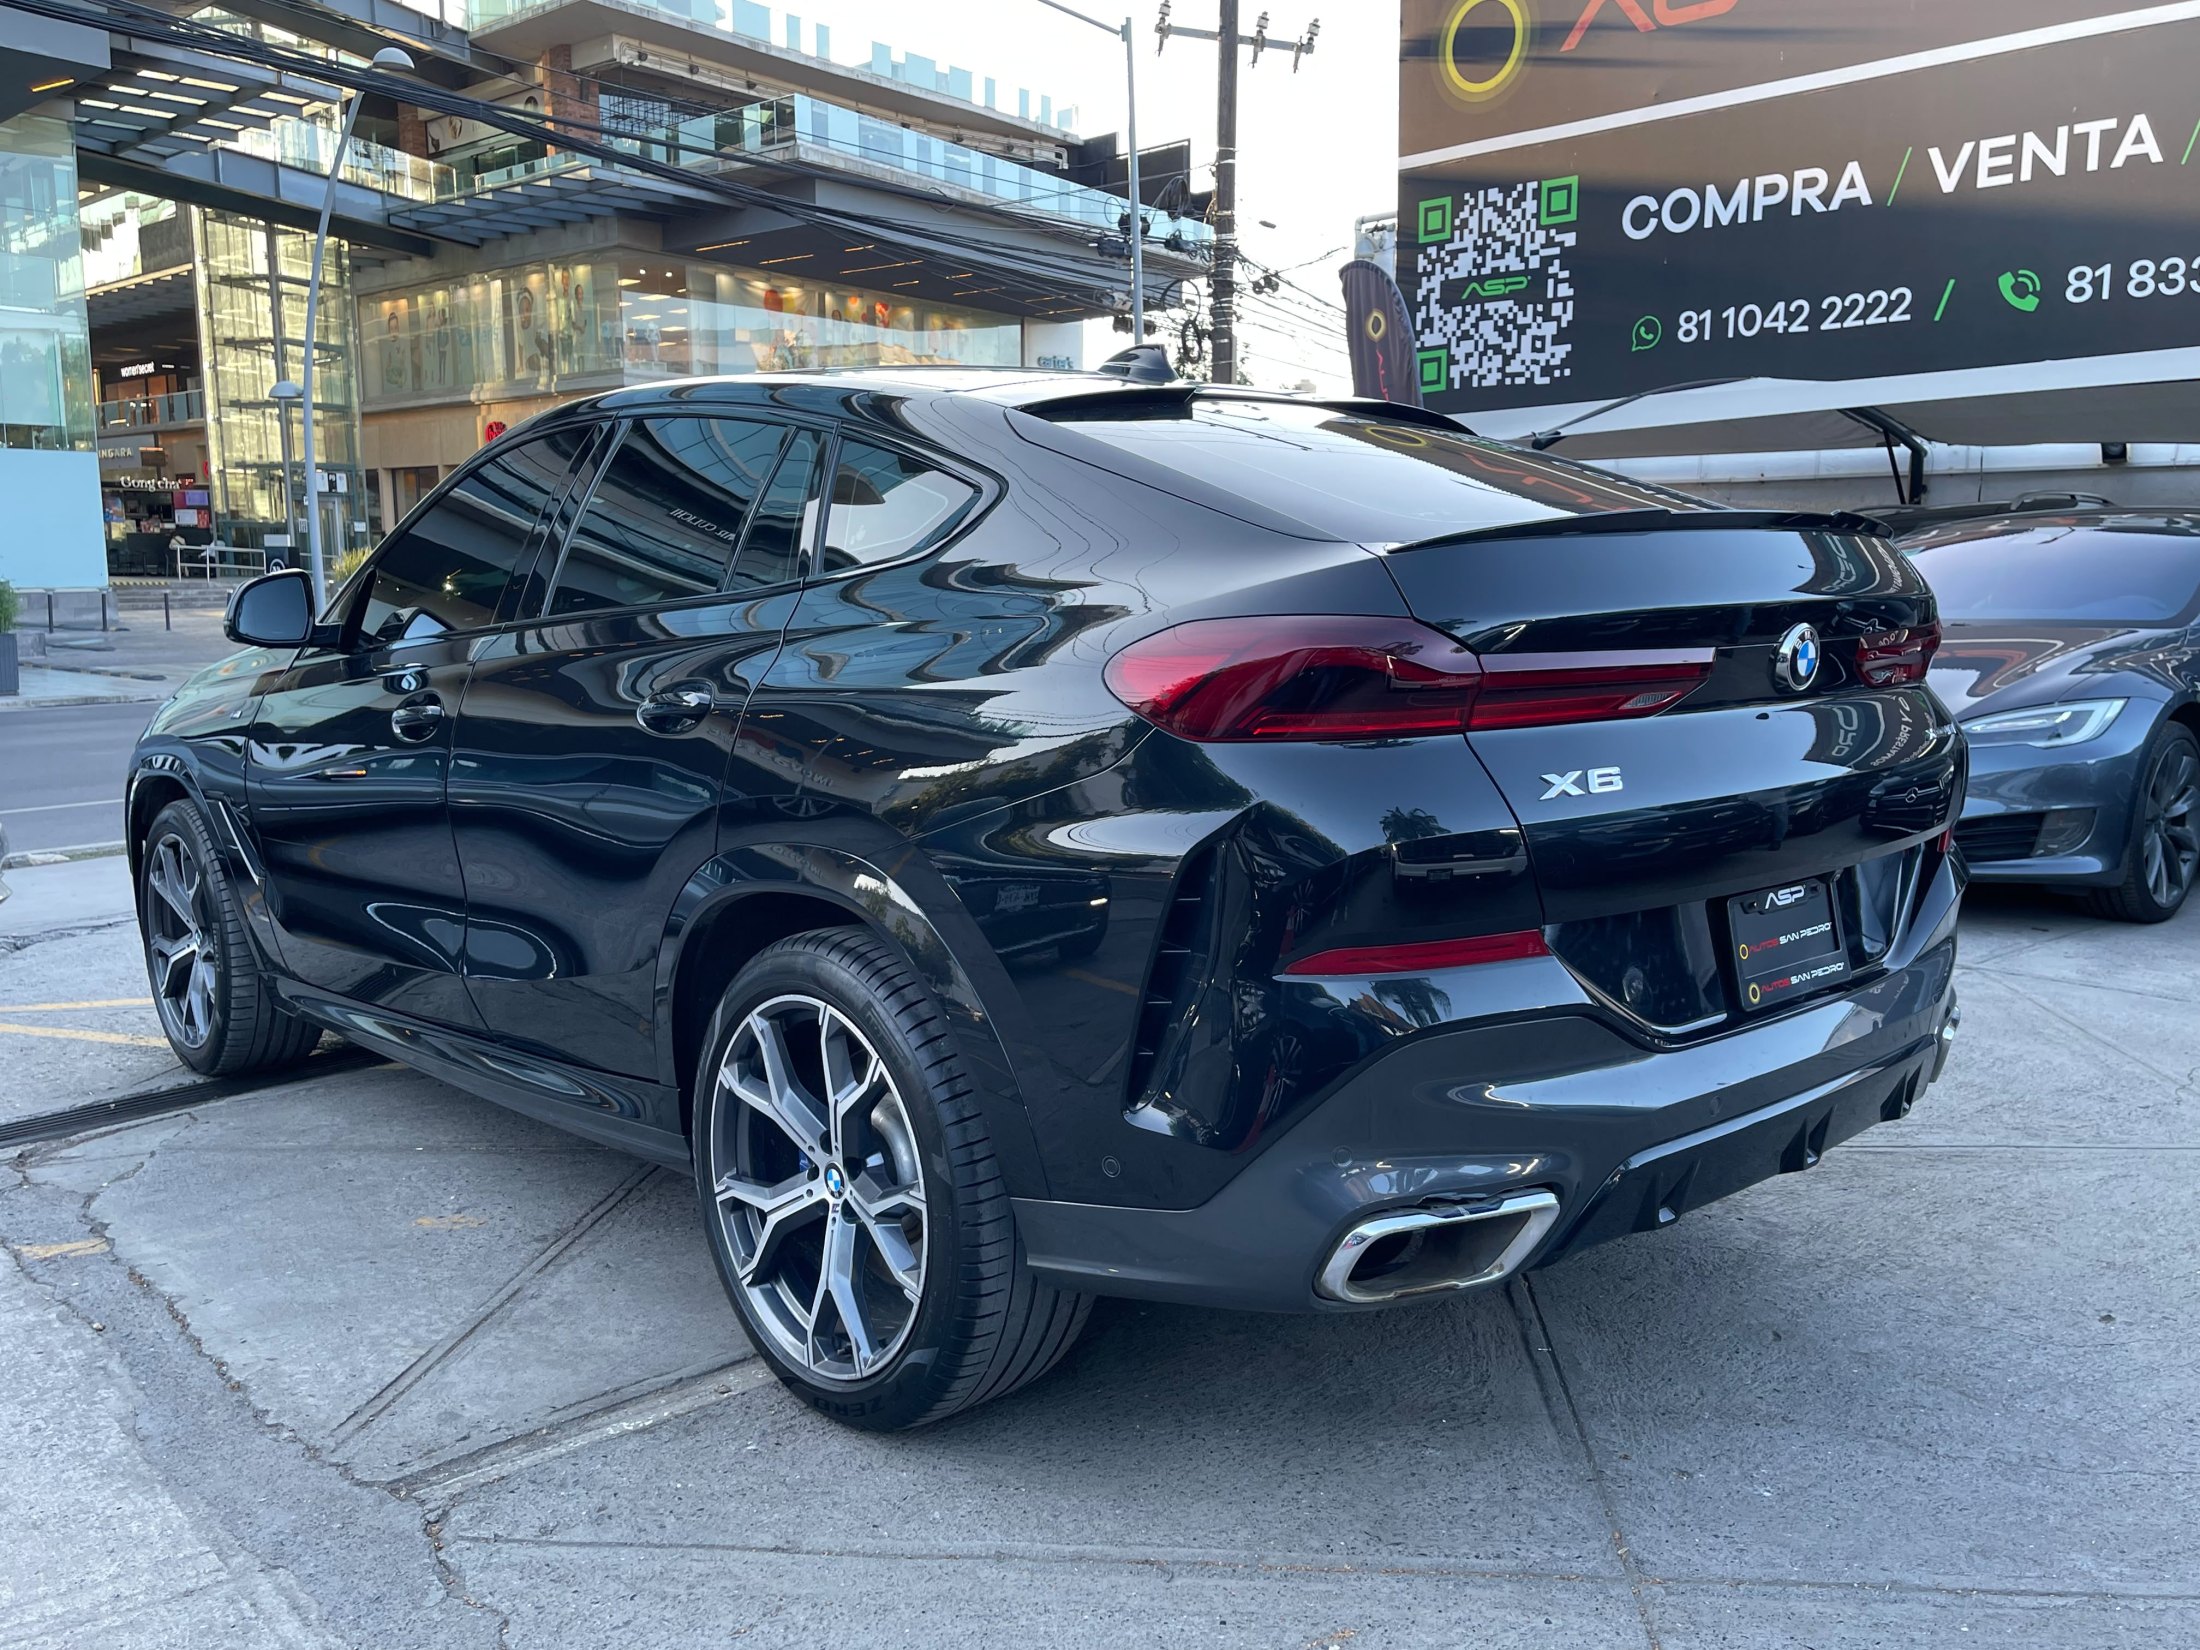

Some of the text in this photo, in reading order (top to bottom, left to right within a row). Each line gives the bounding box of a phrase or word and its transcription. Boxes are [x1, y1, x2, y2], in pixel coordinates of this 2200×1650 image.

[1621, 113, 2164, 240] COMPRA VENTA
[1461, 276, 1528, 299] ASP
[2065, 263, 2111, 304] 81
[1677, 286, 1912, 343] 81 1042 2222
[120, 476, 156, 492] Gong
[158, 476, 181, 490] cha
[1540, 766, 1623, 800] X6
[1764, 885, 1805, 909] ASP
[1780, 932, 1800, 945] SAN
[1800, 922, 1831, 939] PEDRO
[1790, 971, 1811, 985] SAN
[1811, 962, 1844, 979] PEDRO
